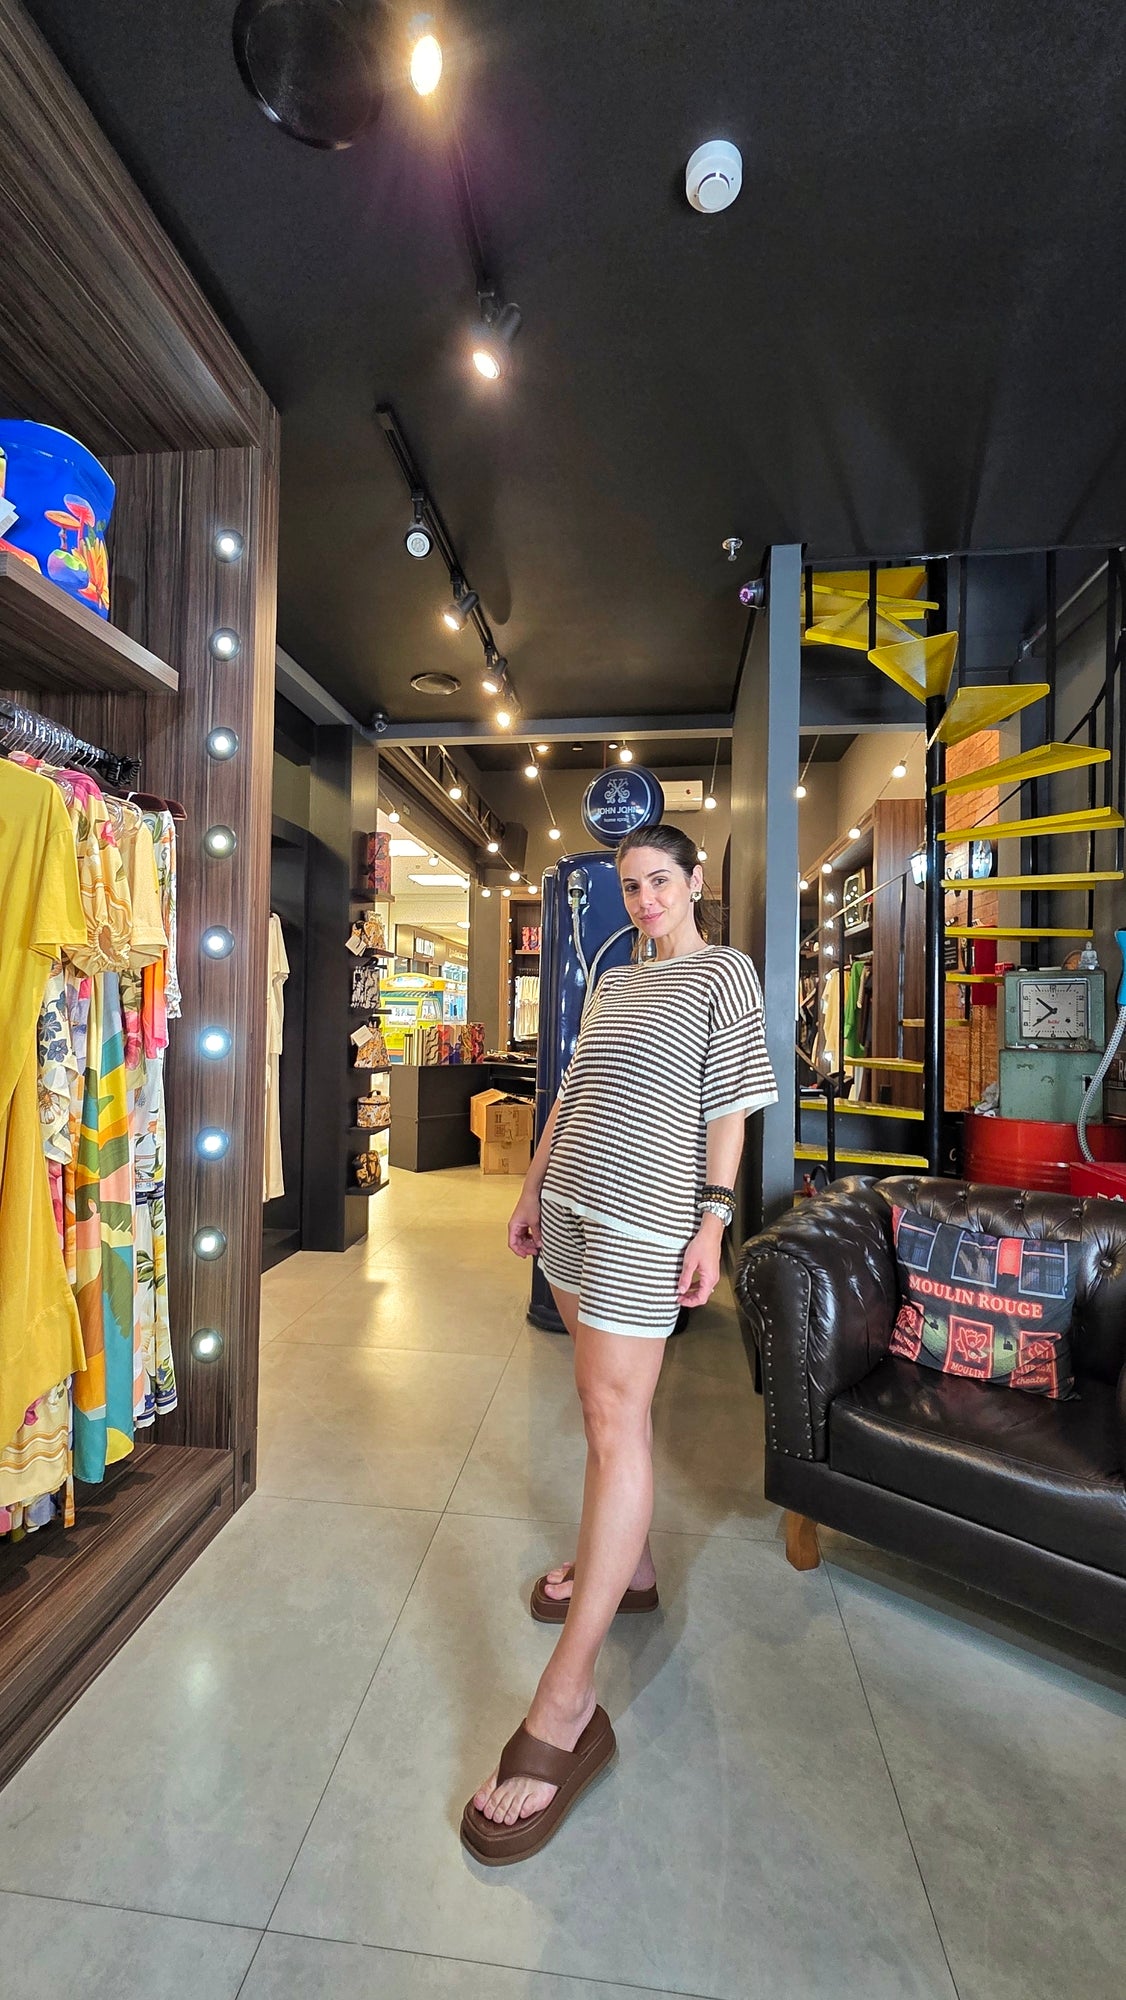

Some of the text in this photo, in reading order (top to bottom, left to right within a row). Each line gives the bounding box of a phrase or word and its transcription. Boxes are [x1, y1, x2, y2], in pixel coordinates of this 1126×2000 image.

[597, 807, 616, 815] JOHN
[909, 1274, 1044, 1319] MOULIN ROUGE
[951, 1361, 985, 1378] MOULIN
